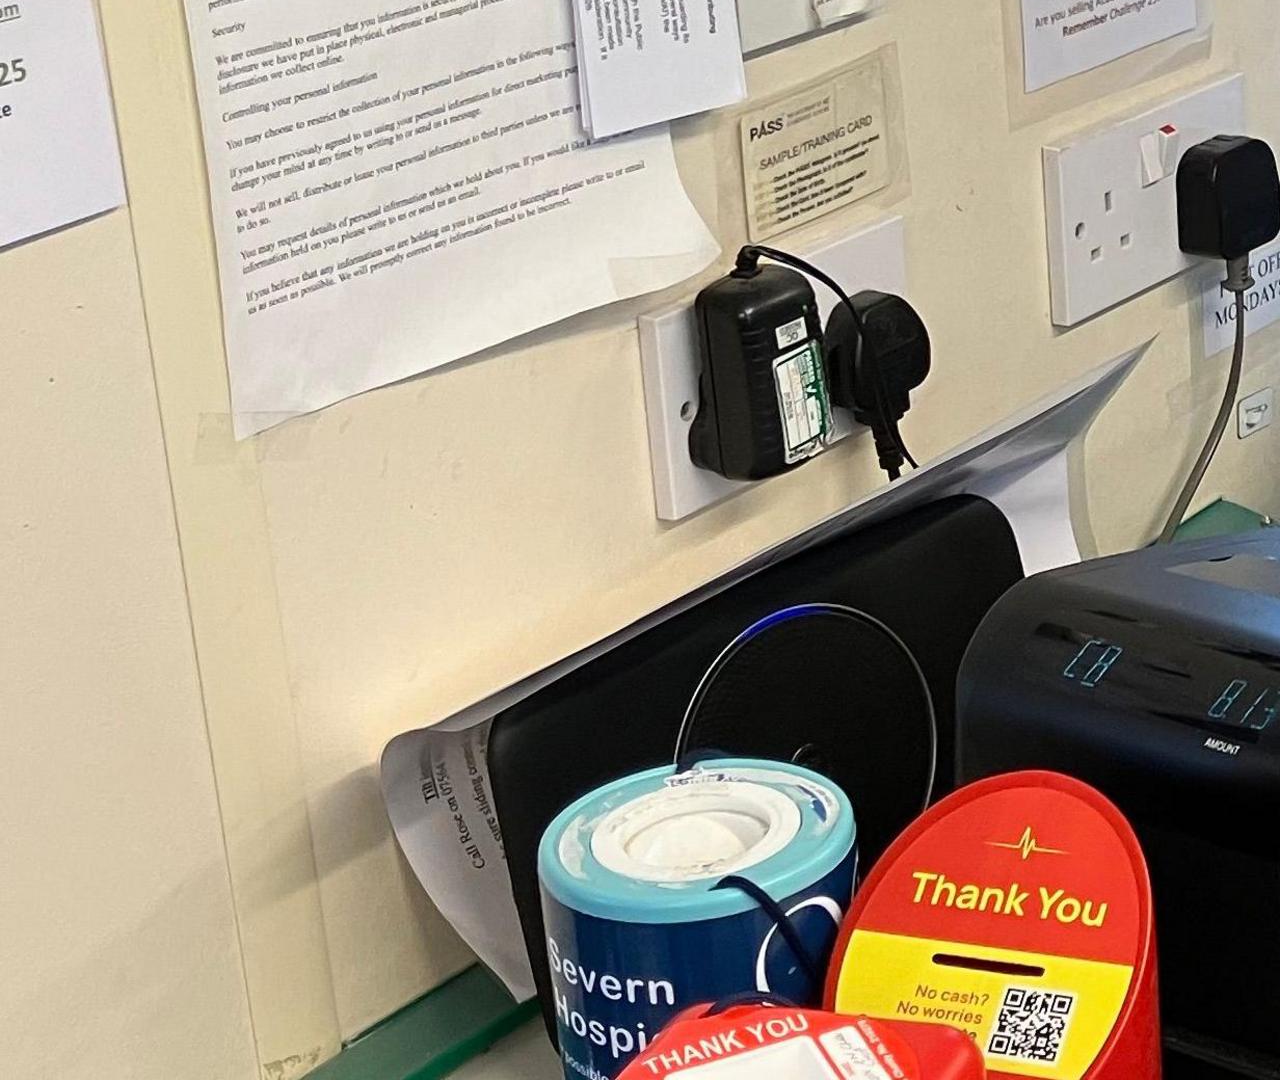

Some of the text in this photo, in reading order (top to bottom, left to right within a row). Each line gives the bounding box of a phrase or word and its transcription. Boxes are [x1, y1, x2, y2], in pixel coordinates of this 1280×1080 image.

[1034, 16, 1049, 29] Are
[1050, 9, 1065, 24] you
[1067, 1, 1094, 18] selling
[1062, 13, 1108, 37] Remember
[1109, 0, 1146, 21] Challenge
[211, 22, 245, 38] Security
[294, 85, 330, 103] personal
[750, 118, 783, 142] PASS
[847, 115, 873, 134] CARD
[1204, 736, 1240, 757] AMOUNT
[421, 778, 439, 804] Till
[447, 795, 486, 869] Call Rose on
[911, 872, 1109, 928] Thank You
[549, 937, 675, 1005] Severn
[915, 984, 990, 1007] No cash?
[553, 988, 661, 1059] Hospi
[896, 1000, 984, 1025] No worries
[642, 1029, 744, 1075] THANK
[746, 1014, 808, 1044] YOU
